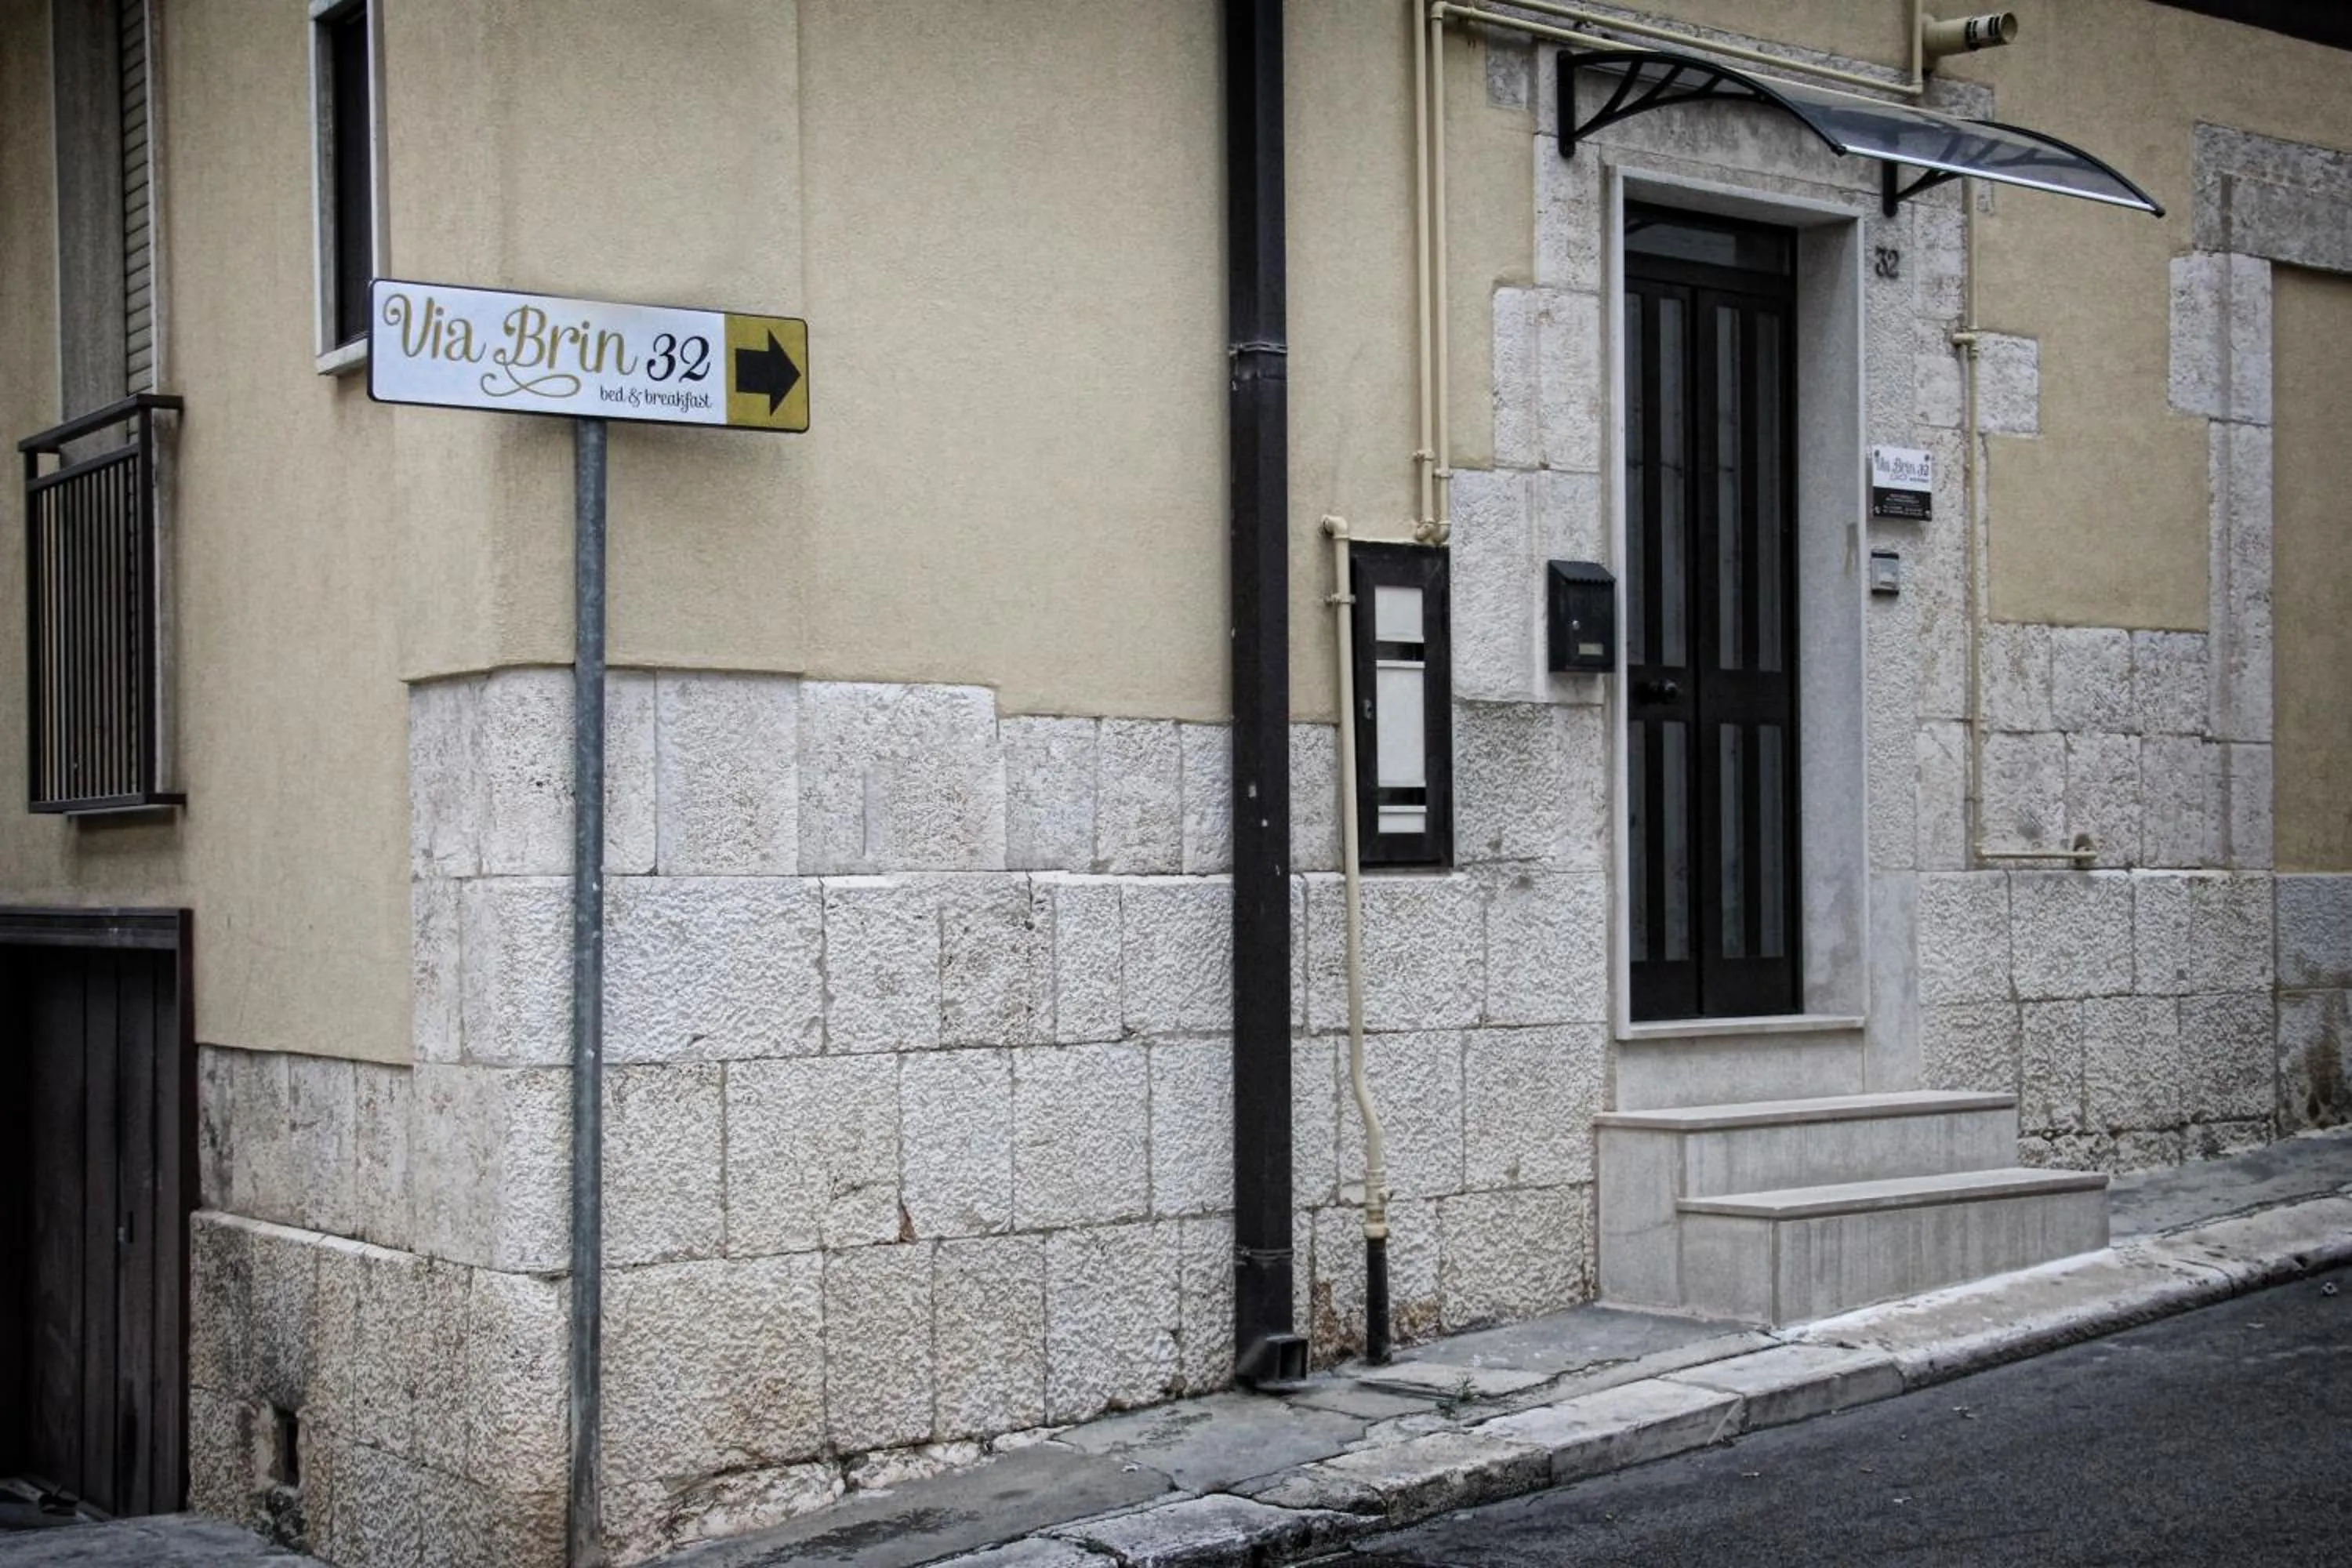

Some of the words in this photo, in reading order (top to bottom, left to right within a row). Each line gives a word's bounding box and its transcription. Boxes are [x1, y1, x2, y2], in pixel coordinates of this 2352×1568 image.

[1875, 245, 1900, 280] 32
[383, 293, 486, 364] Via
[481, 304, 638, 397] Brin
[647, 332, 711, 383] 32
[600, 384, 625, 402] bed
[628, 387, 642, 408] &
[644, 388, 712, 413] breakfast
